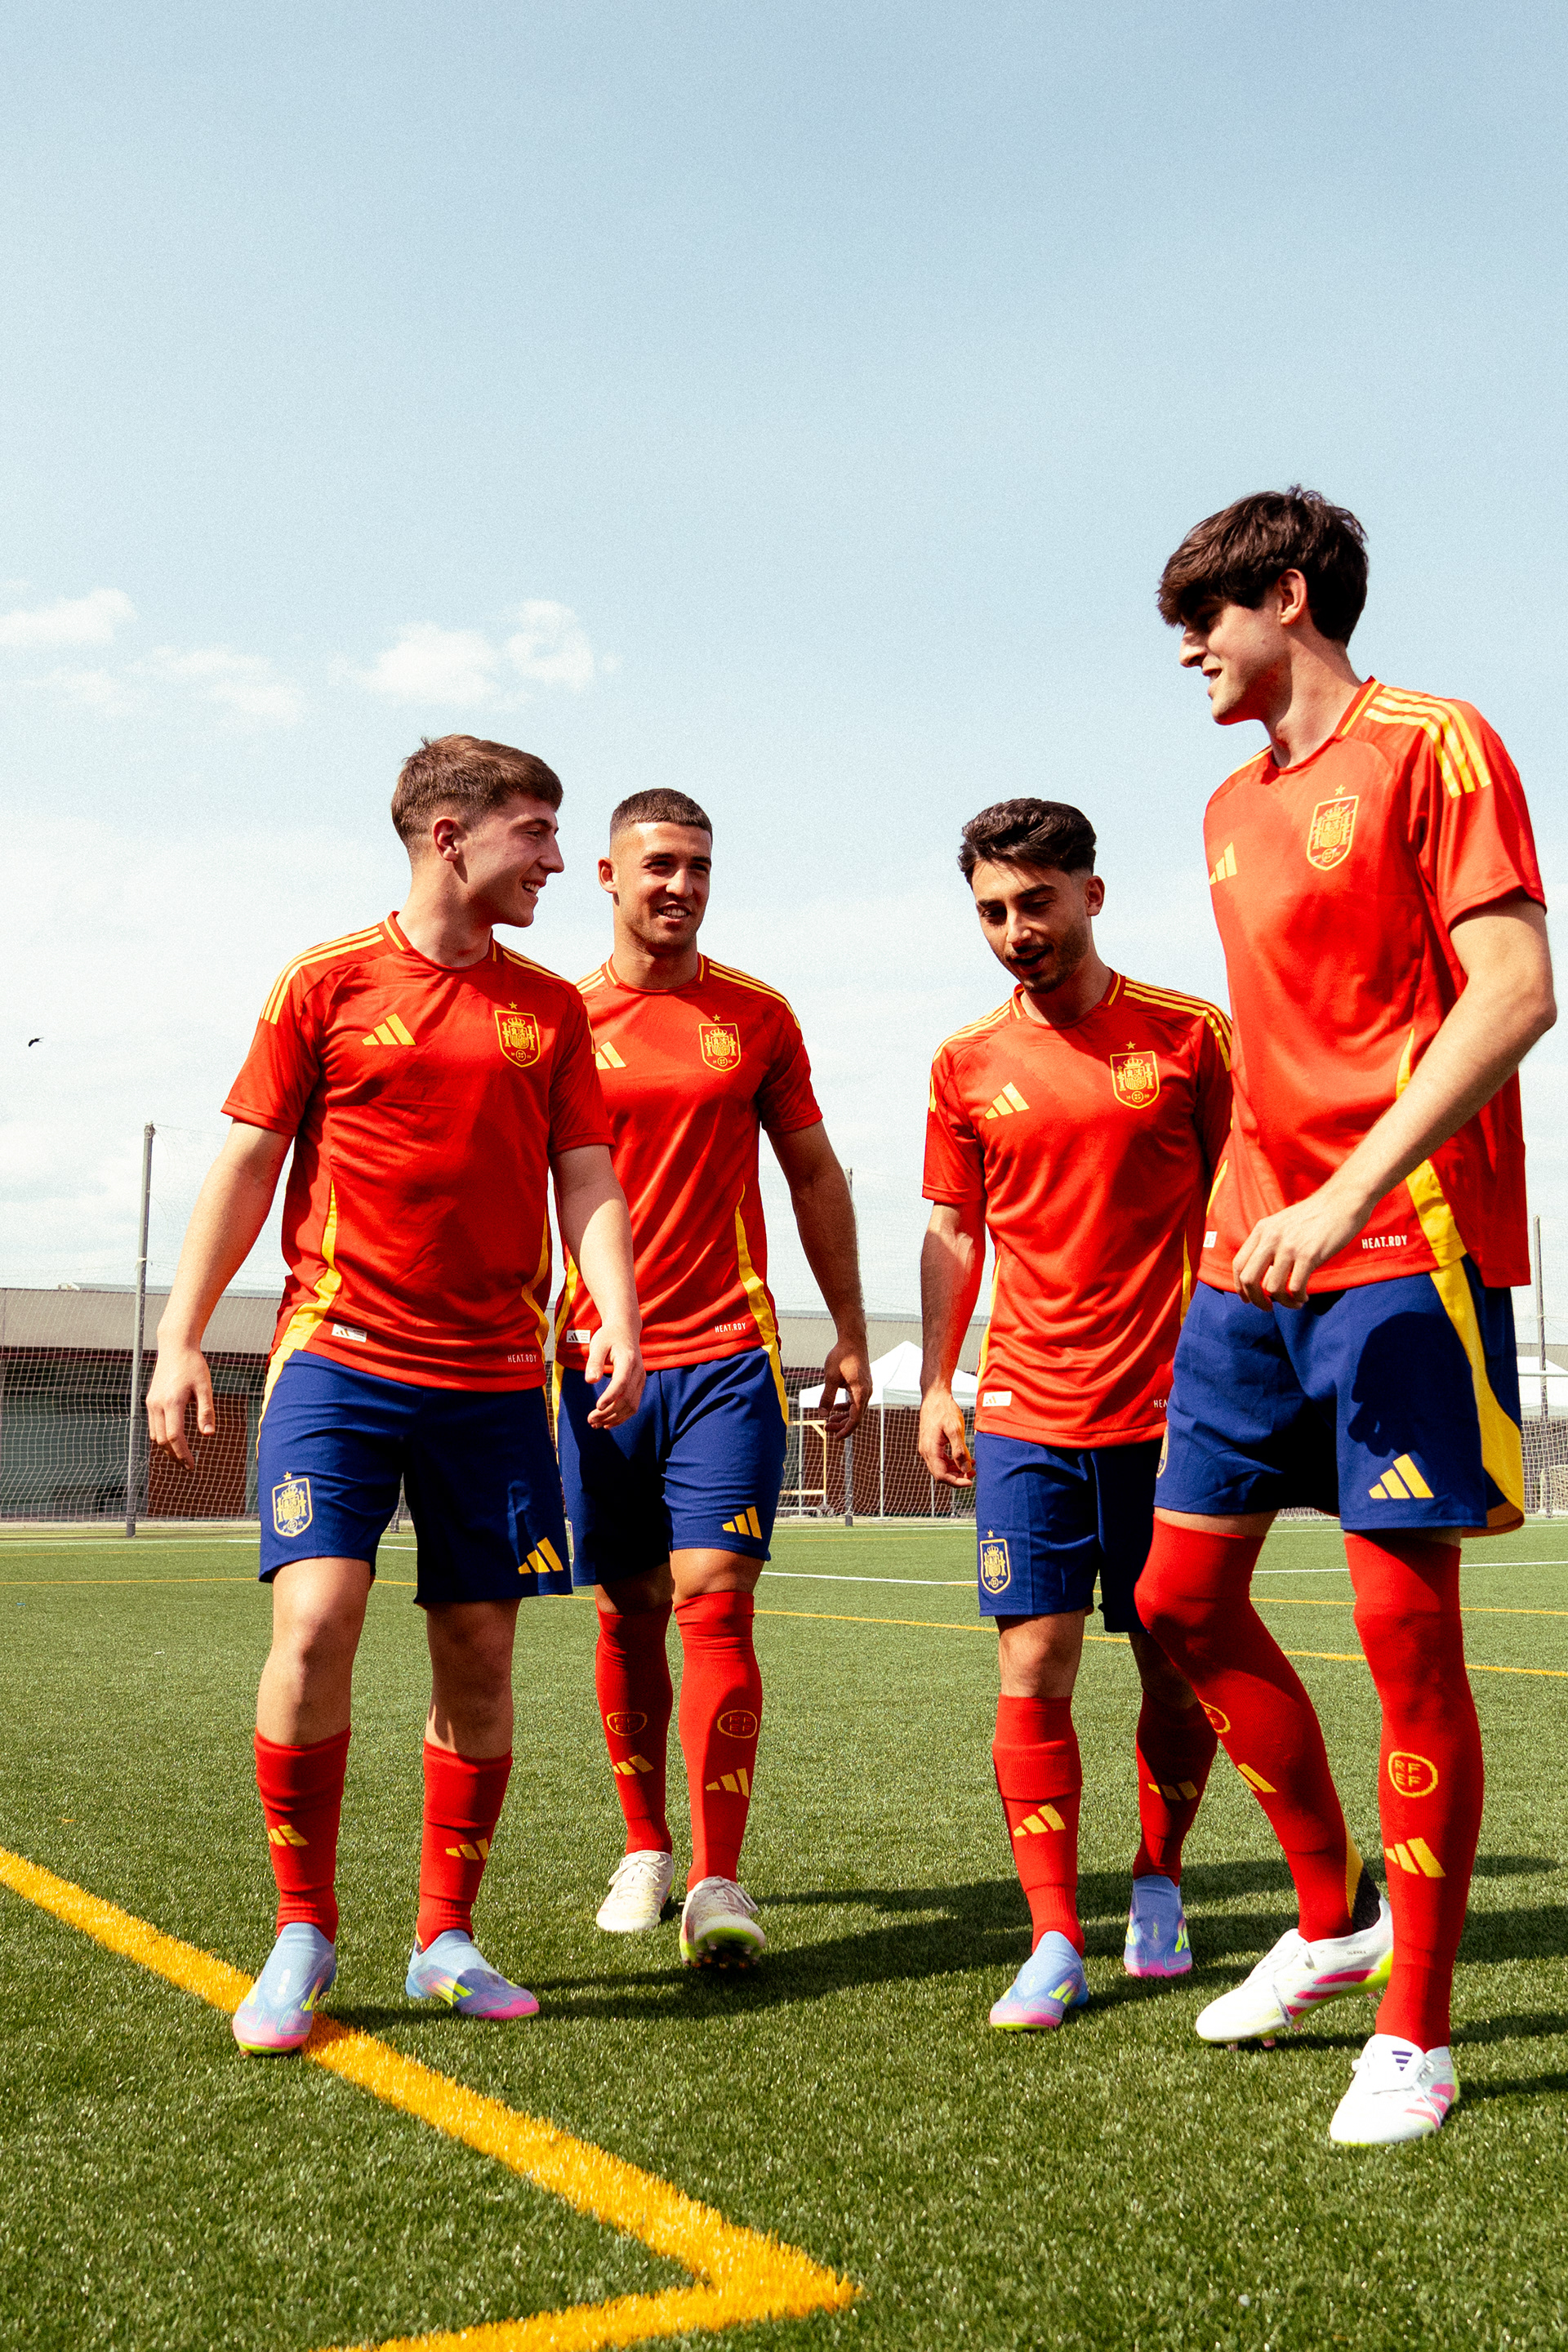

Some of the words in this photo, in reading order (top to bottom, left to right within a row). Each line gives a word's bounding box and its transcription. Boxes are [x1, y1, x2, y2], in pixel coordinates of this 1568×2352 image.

[1361, 1235, 1407, 1250] HEAT.RDY
[715, 1322, 746, 1333] HEAT.RDY
[507, 1353, 537, 1363] HEAT.RDY
[1153, 1399, 1168, 1409] HEA
